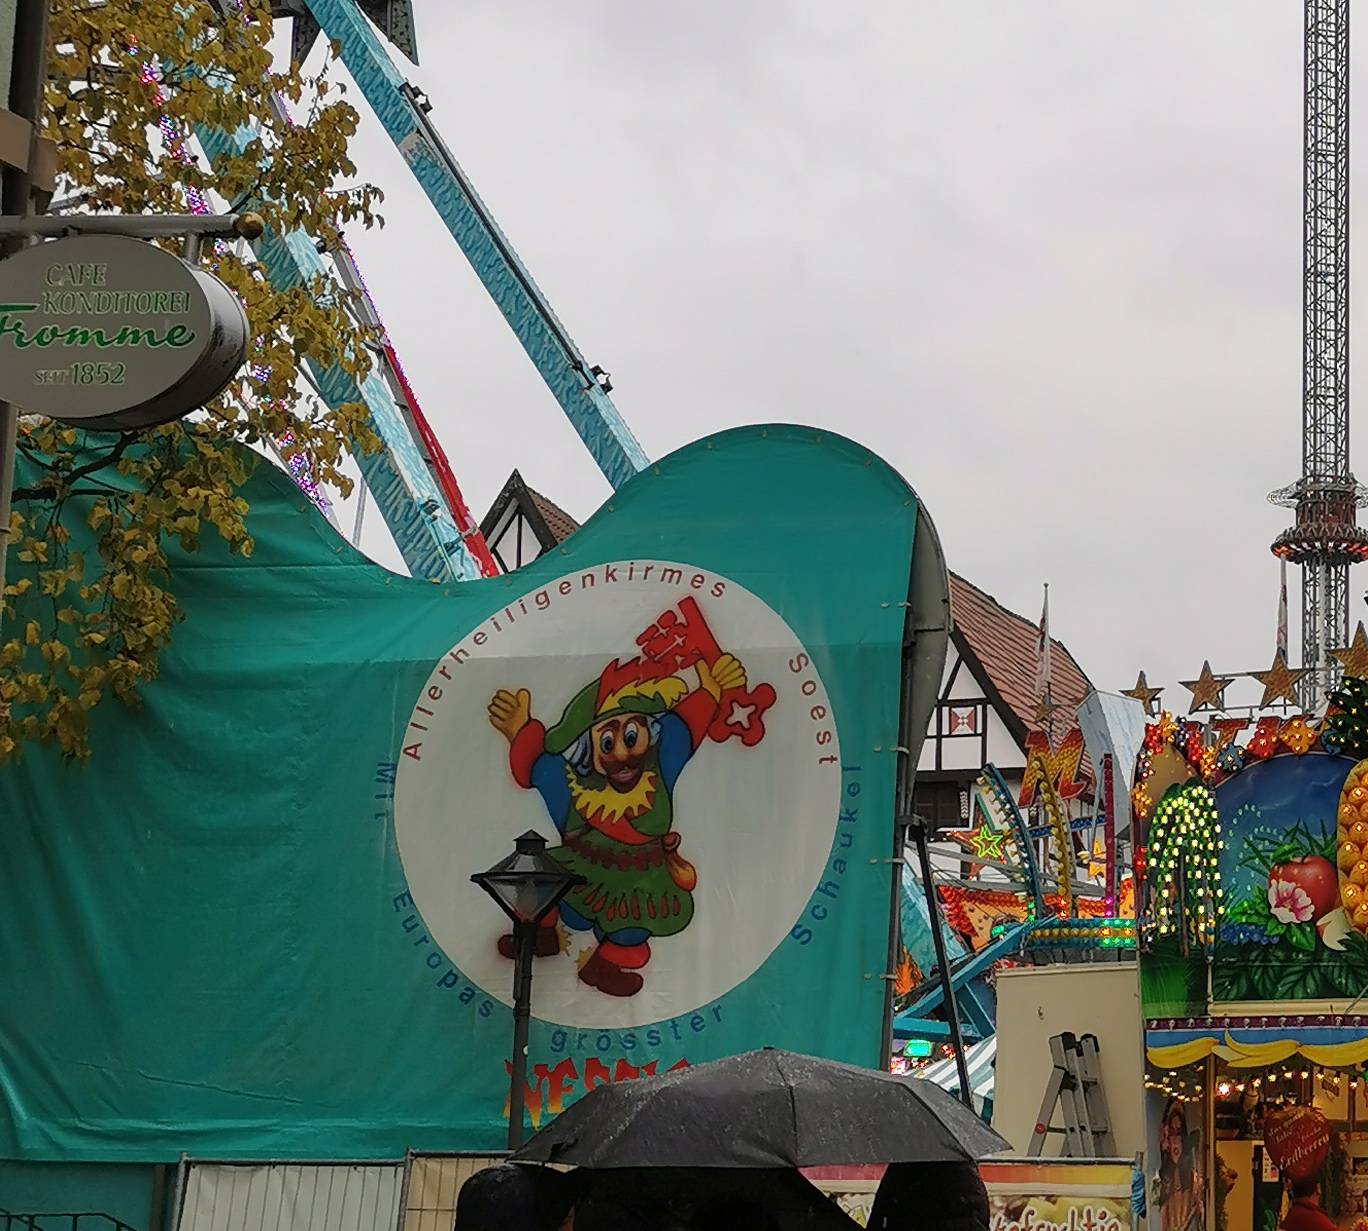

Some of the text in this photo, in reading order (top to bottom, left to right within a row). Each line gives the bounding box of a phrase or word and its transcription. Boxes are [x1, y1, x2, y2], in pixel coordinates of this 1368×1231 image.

[42, 289, 191, 315] KONDITOREI
[71, 361, 128, 386] 1852
[401, 561, 839, 766] Allerheiligenkirmes Soest
[393, 890, 493, 1019] Europas
[791, 764, 862, 947] Schaukel
